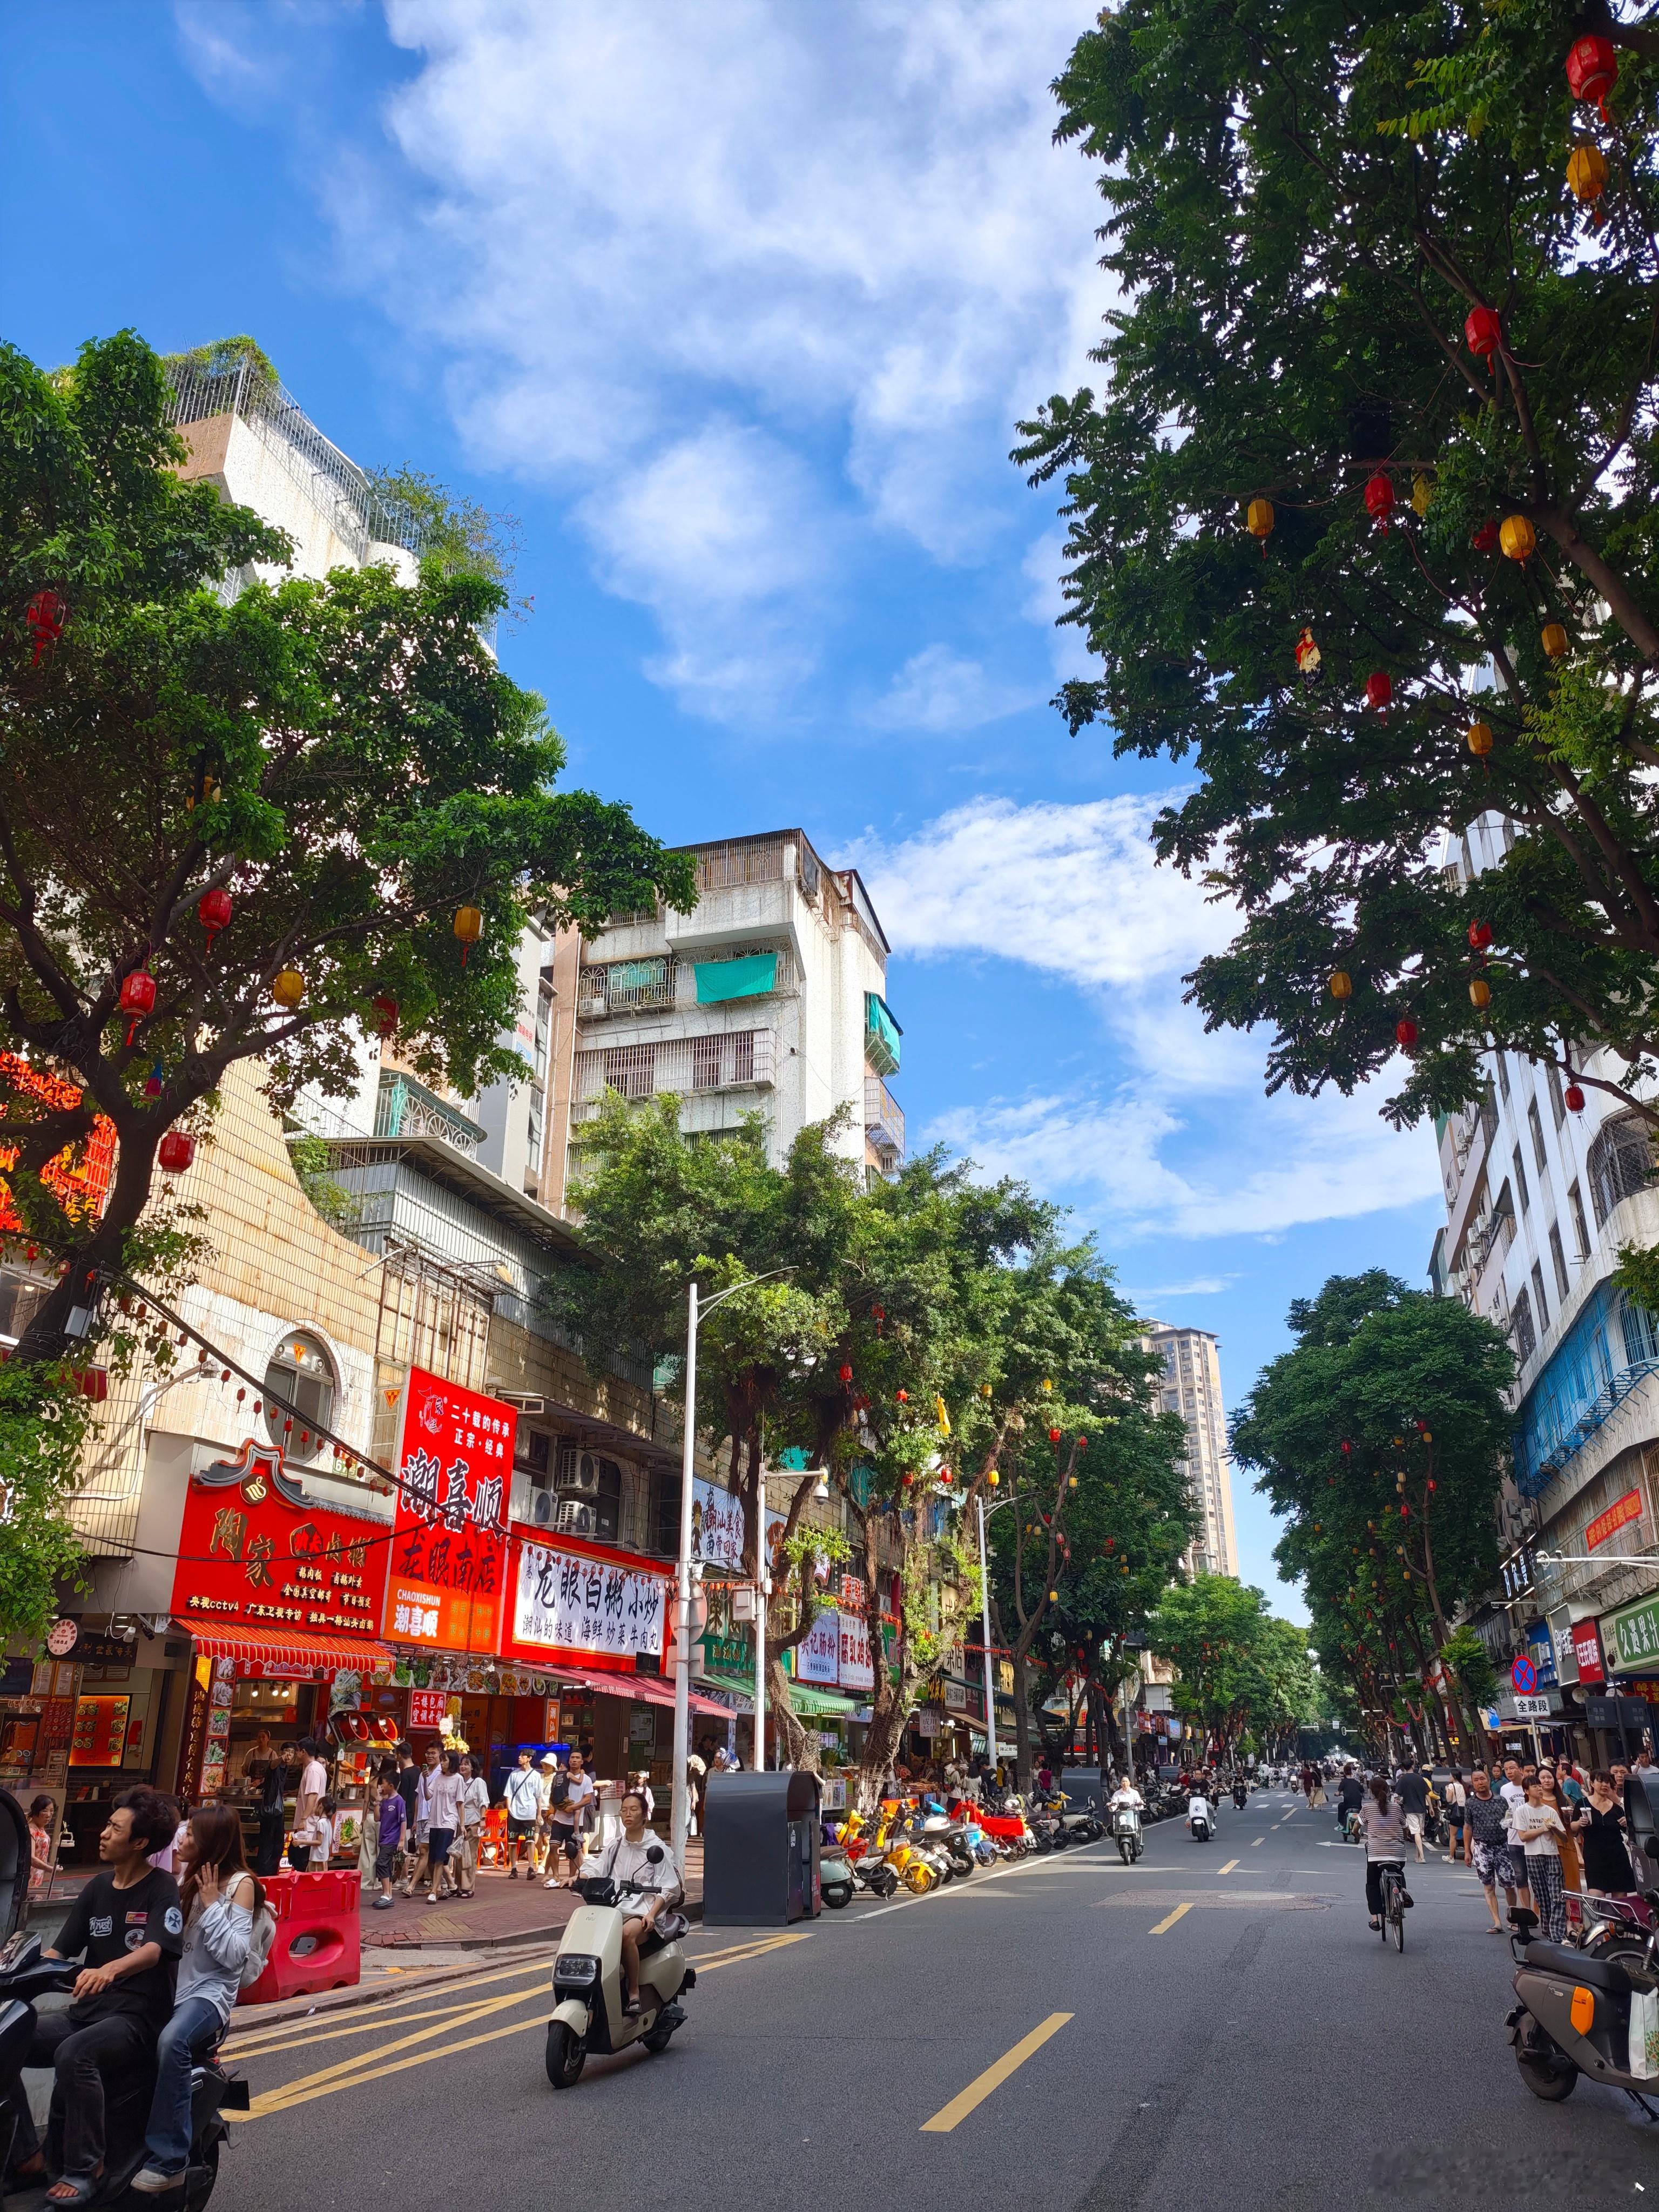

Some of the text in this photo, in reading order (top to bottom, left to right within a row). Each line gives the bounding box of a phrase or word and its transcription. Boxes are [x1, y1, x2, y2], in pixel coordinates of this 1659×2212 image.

[451, 1405, 510, 1438] 二十载的传承
[401, 1447, 507, 1539] 潮喜顺
[284, 1583, 332, 1603] 全国真空邮寄
[397, 1589, 441, 1607] CHAOXISHUN
[534, 1550, 659, 1625] 龙眼白粥小炒
[247, 1603, 302, 1621] 广东卫视专访
[309, 1611, 374, 1631] 独具一格汕头卤鹅
[394, 1603, 439, 1638] 潮喜顺
[522, 1615, 573, 1643] 潮汕的味道
[581, 1616, 659, 1650] 海鲜炒菜牛肉丸
[1518, 1700, 1548, 1713] 全路段
